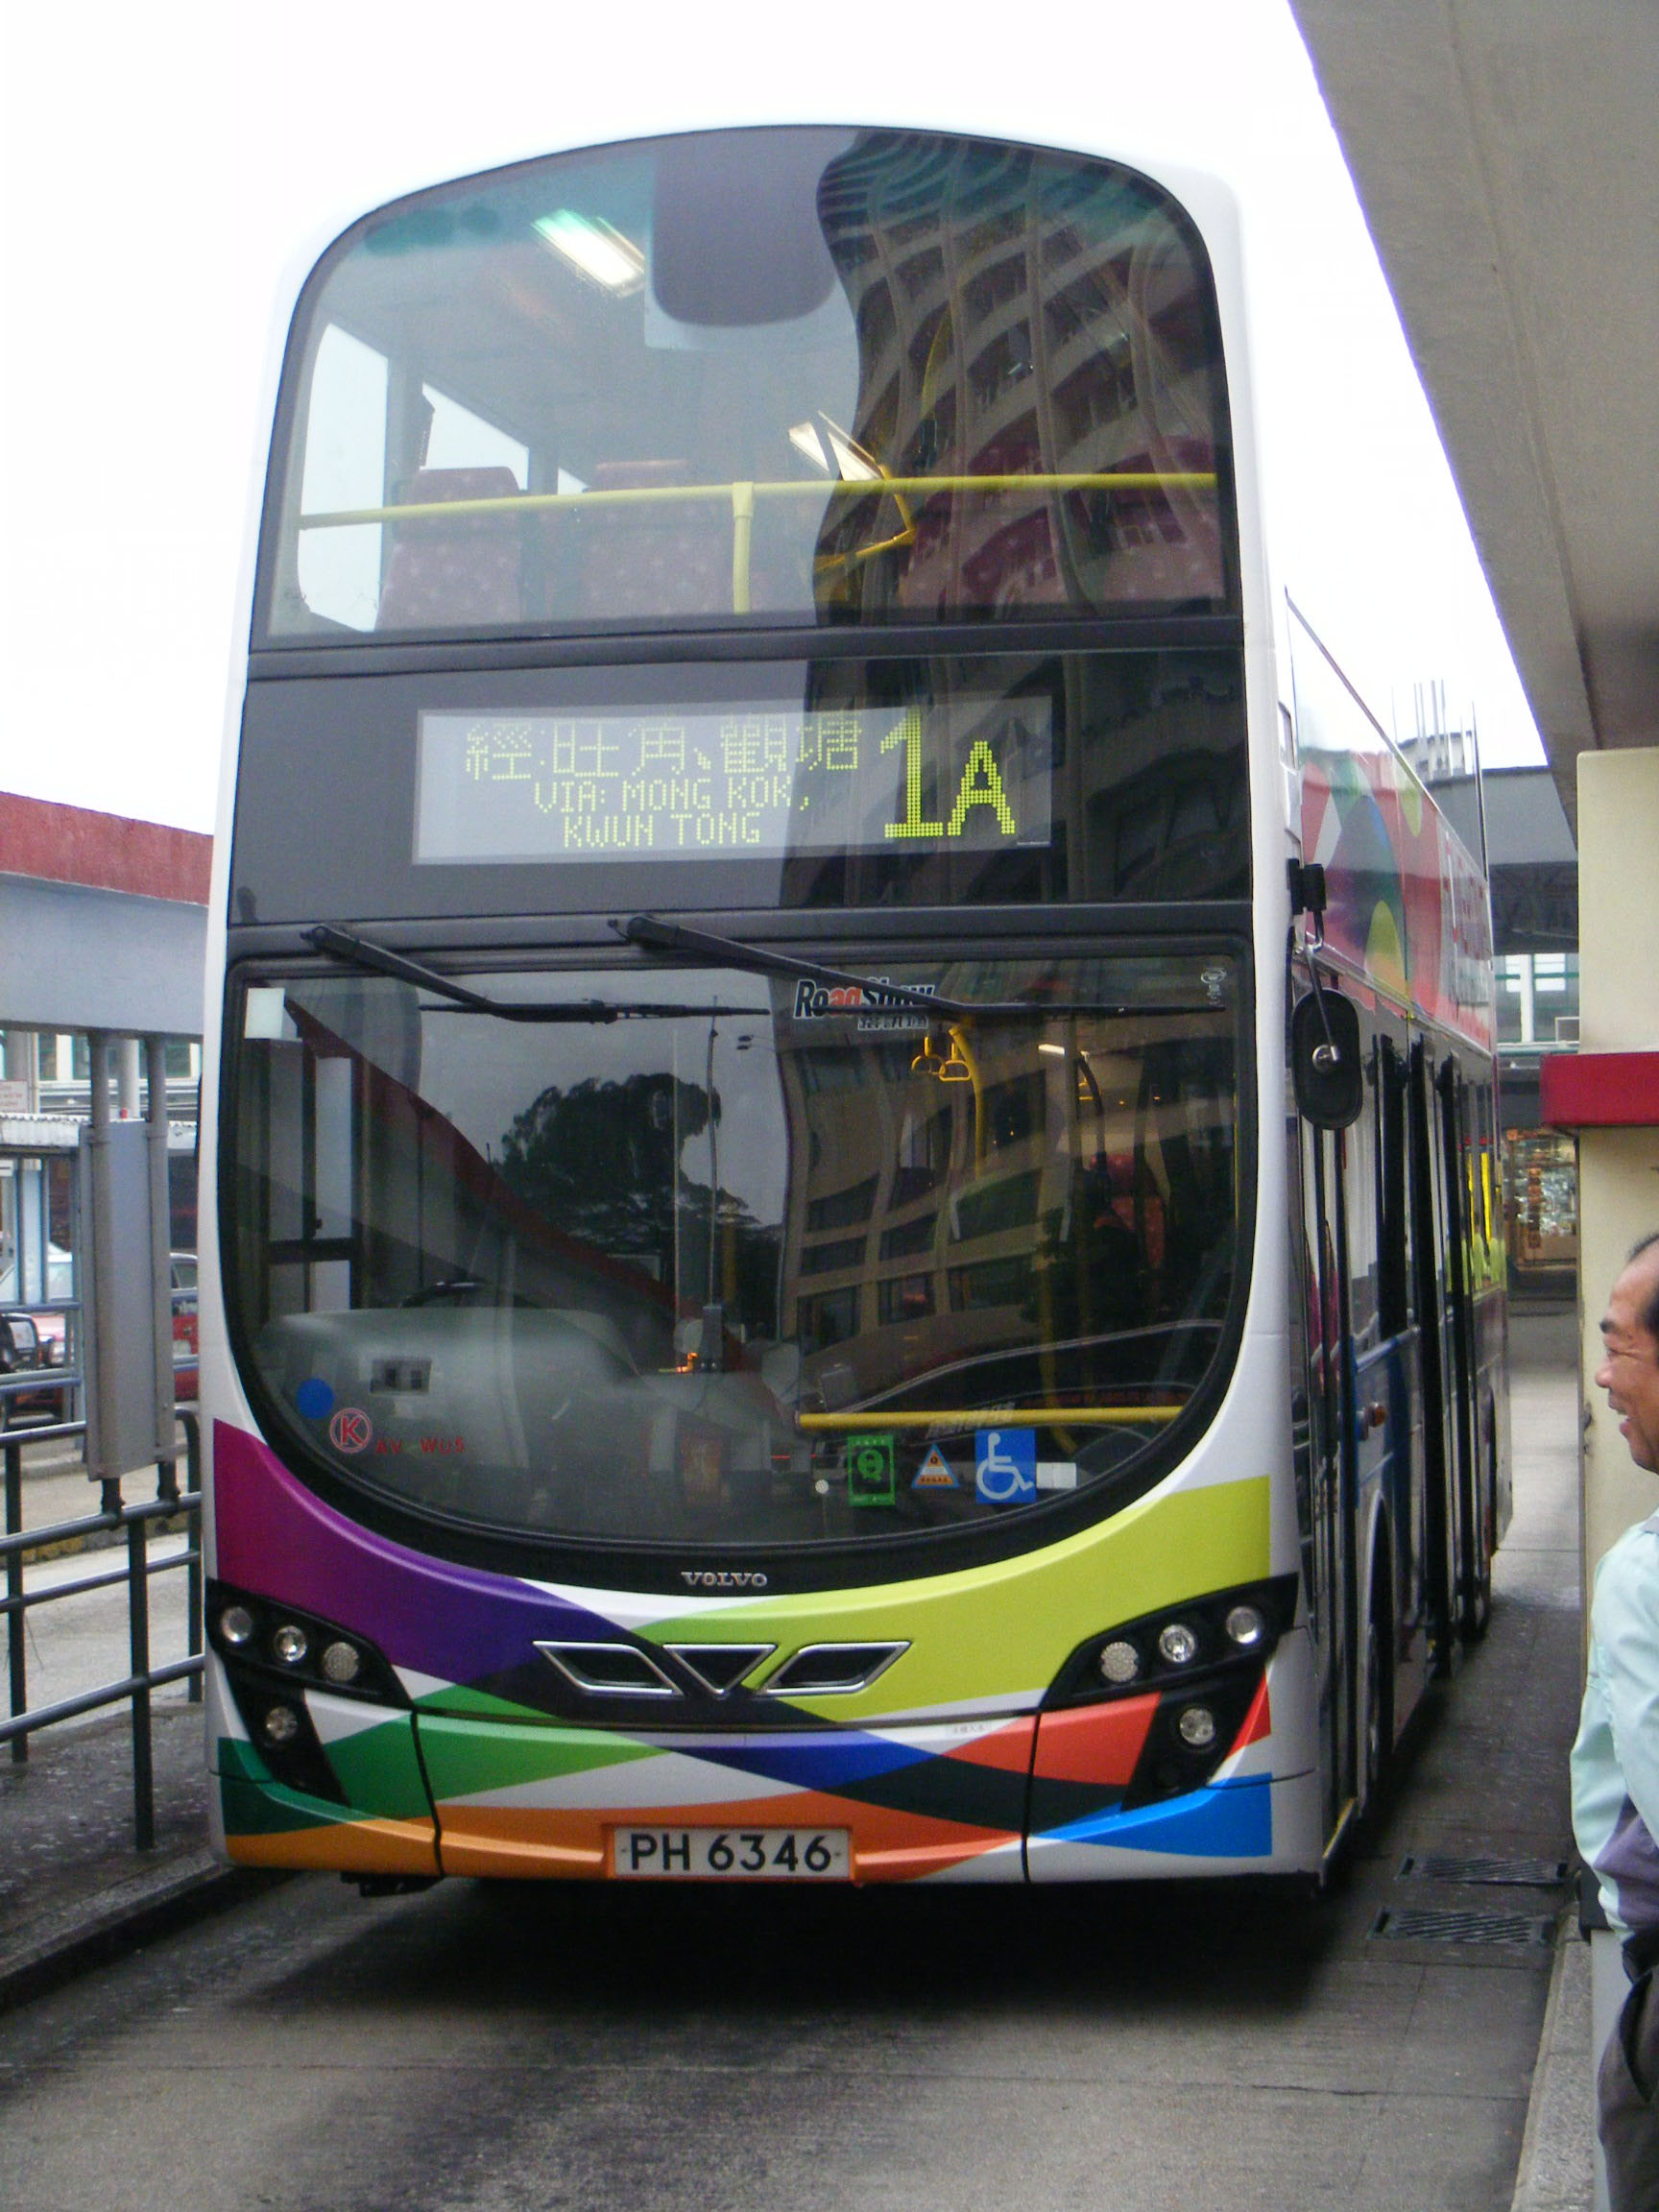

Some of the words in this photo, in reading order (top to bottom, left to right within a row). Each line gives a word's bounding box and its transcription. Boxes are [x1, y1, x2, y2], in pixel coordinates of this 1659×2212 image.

[880, 705, 1016, 836] 1A
[534, 780, 606, 813] VIA:
[622, 778, 711, 812] MONG
[564, 814, 654, 849] KWUN
[670, 811, 760, 846] TONG
[680, 1571, 768, 1588] VOLVO
[630, 1833, 691, 1871] PH
[707, 1834, 832, 1872] 6346
